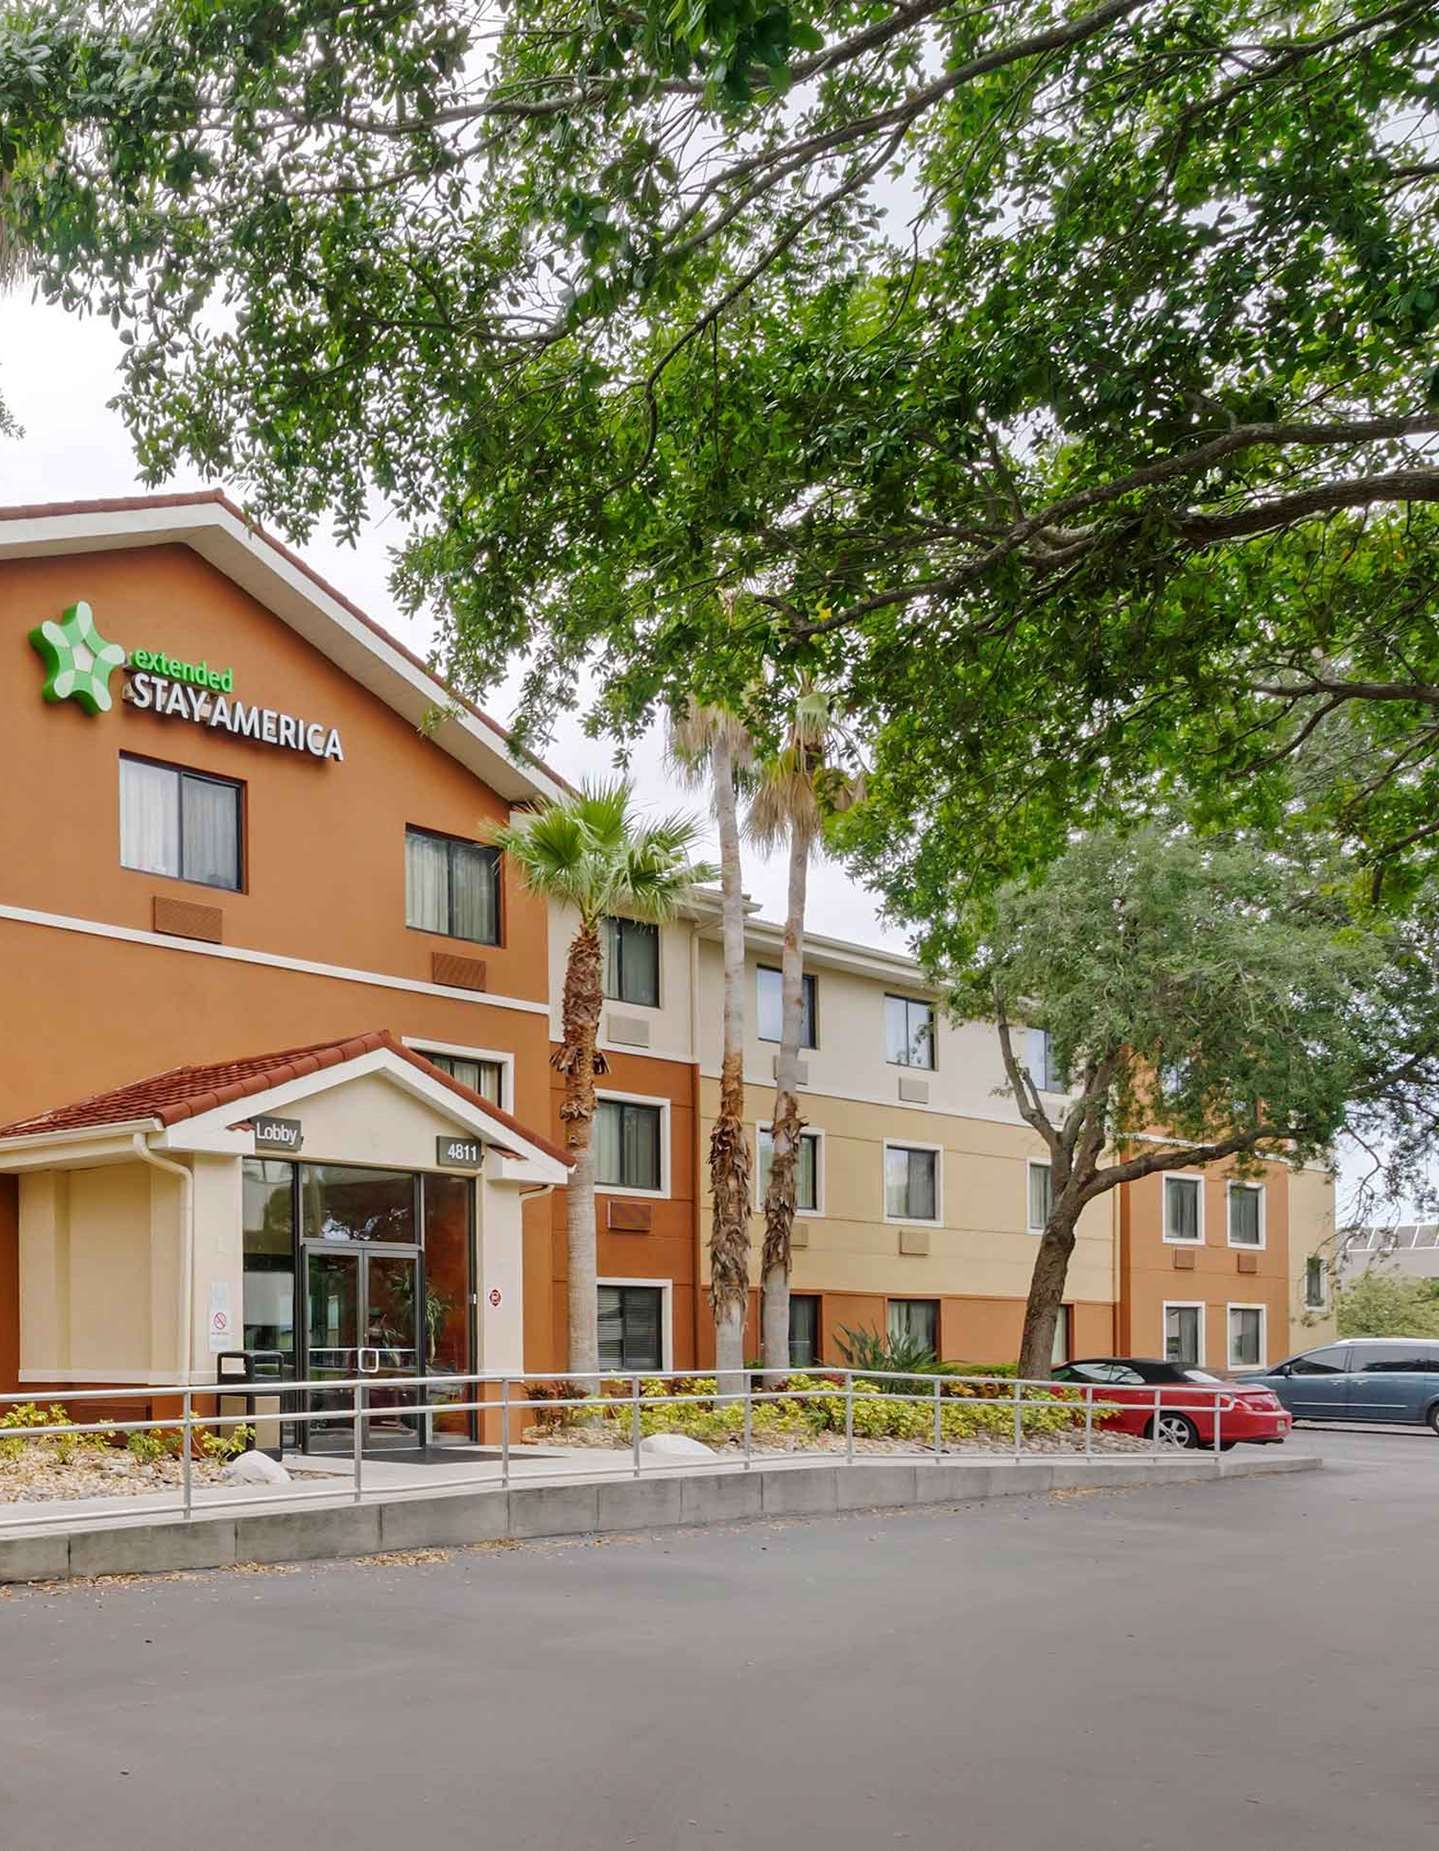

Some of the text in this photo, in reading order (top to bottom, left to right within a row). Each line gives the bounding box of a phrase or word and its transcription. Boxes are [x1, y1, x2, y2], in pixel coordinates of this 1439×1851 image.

[134, 649, 233, 692] extended
[133, 673, 344, 760] STAY AMERICA
[257, 1122, 298, 1145] Lobby
[448, 1143, 477, 1161] 4811
